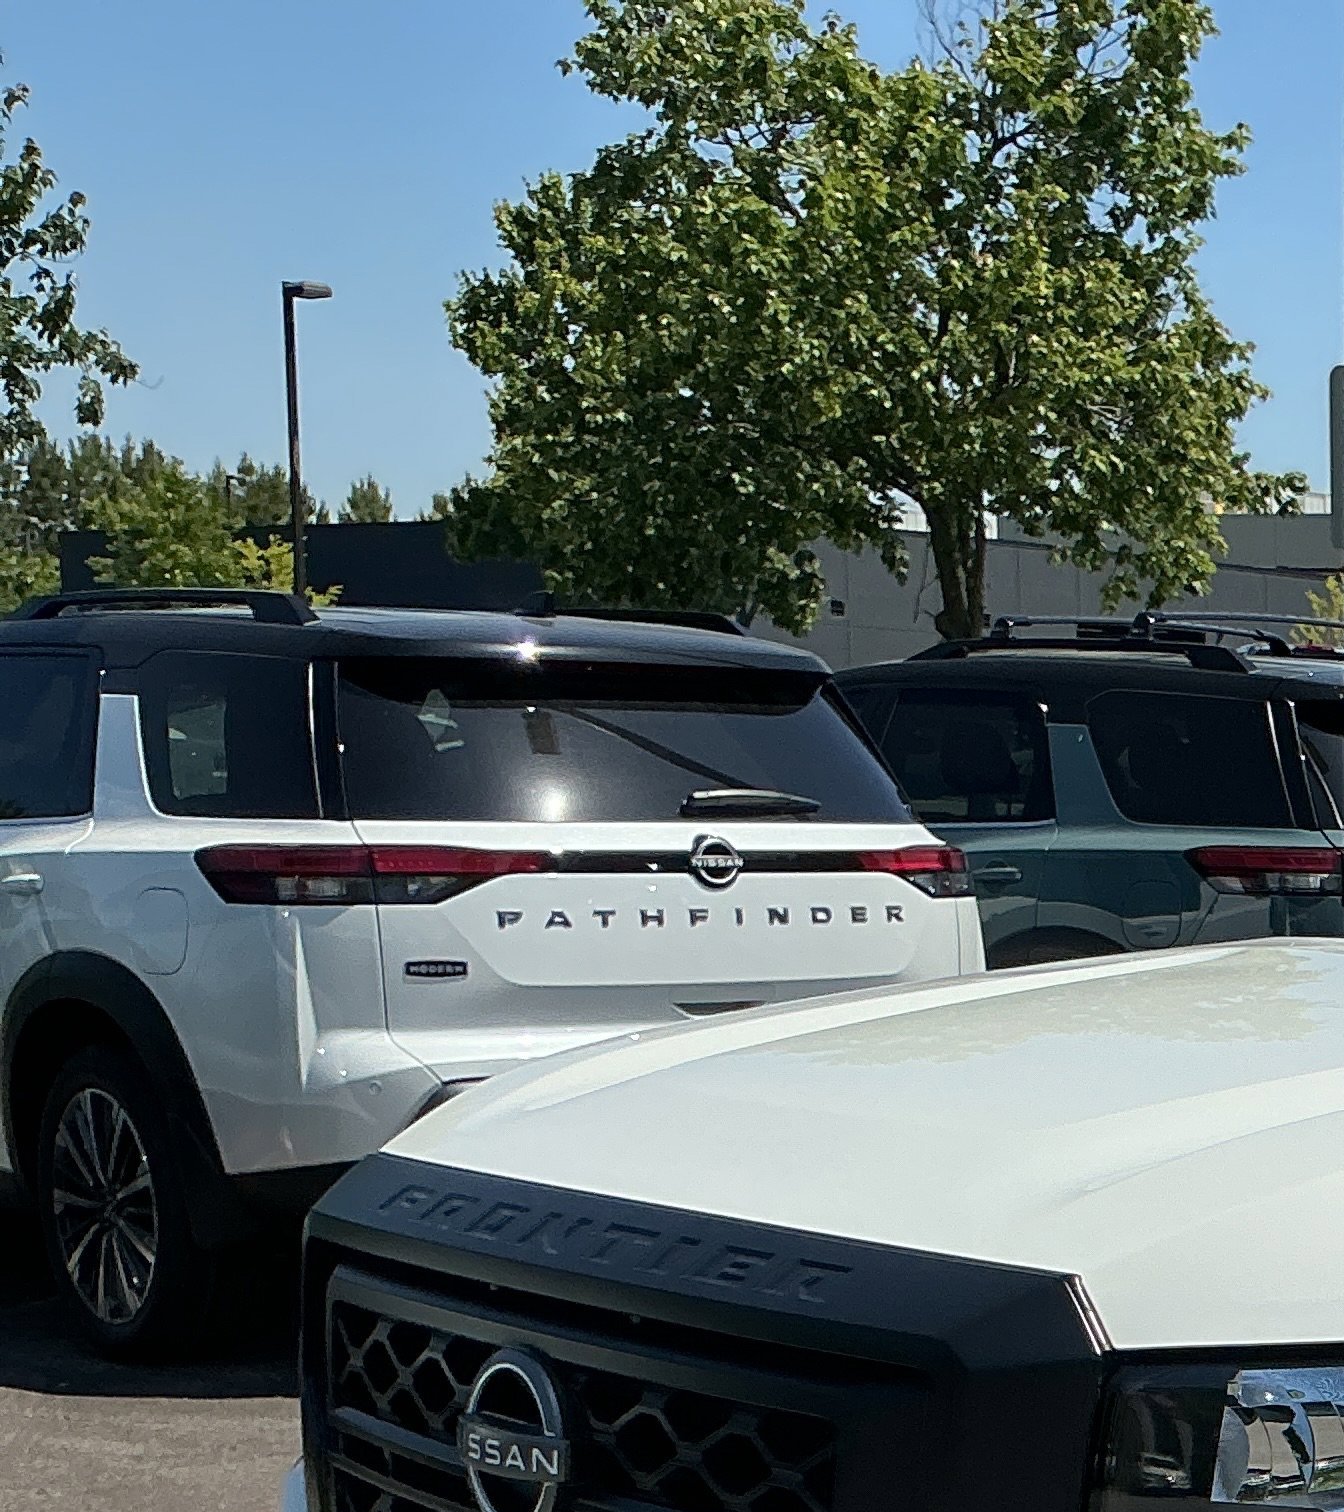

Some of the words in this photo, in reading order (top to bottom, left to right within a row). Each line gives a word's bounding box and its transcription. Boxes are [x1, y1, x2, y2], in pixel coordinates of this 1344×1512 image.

[690, 857, 744, 868] NISSAN
[495, 905, 906, 929] PATHFINDER
[378, 1183, 853, 1304] FRONTIER
[467, 1432, 559, 1475] SSAN
